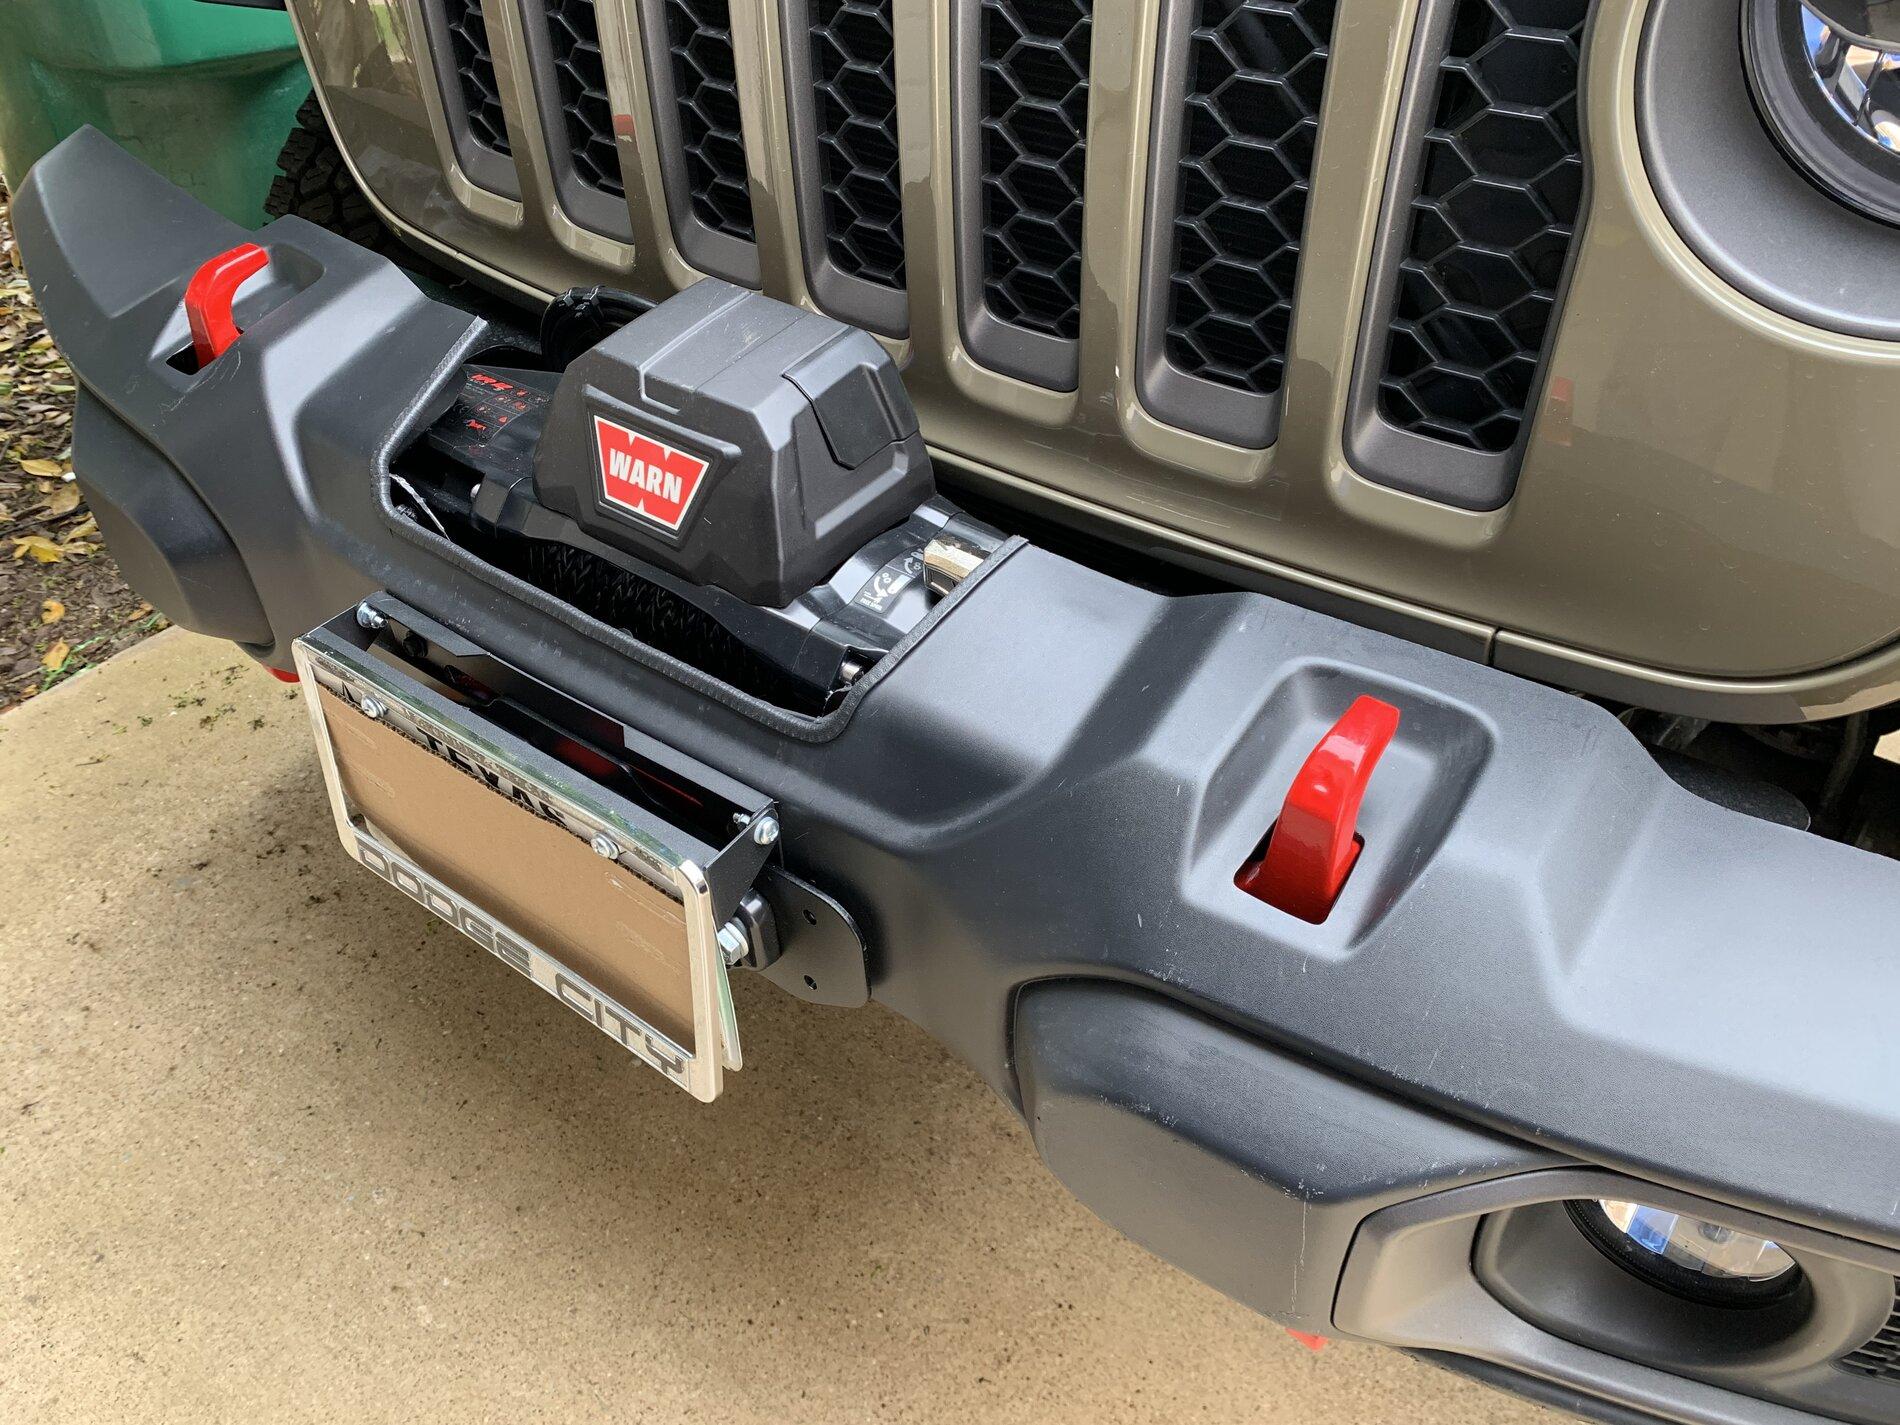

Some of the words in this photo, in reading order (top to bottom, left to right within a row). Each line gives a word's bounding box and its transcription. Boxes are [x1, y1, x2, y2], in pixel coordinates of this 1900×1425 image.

[609, 448, 683, 504] WARN
[356, 837, 532, 977] DODGE
[555, 973, 684, 1074] CITY
